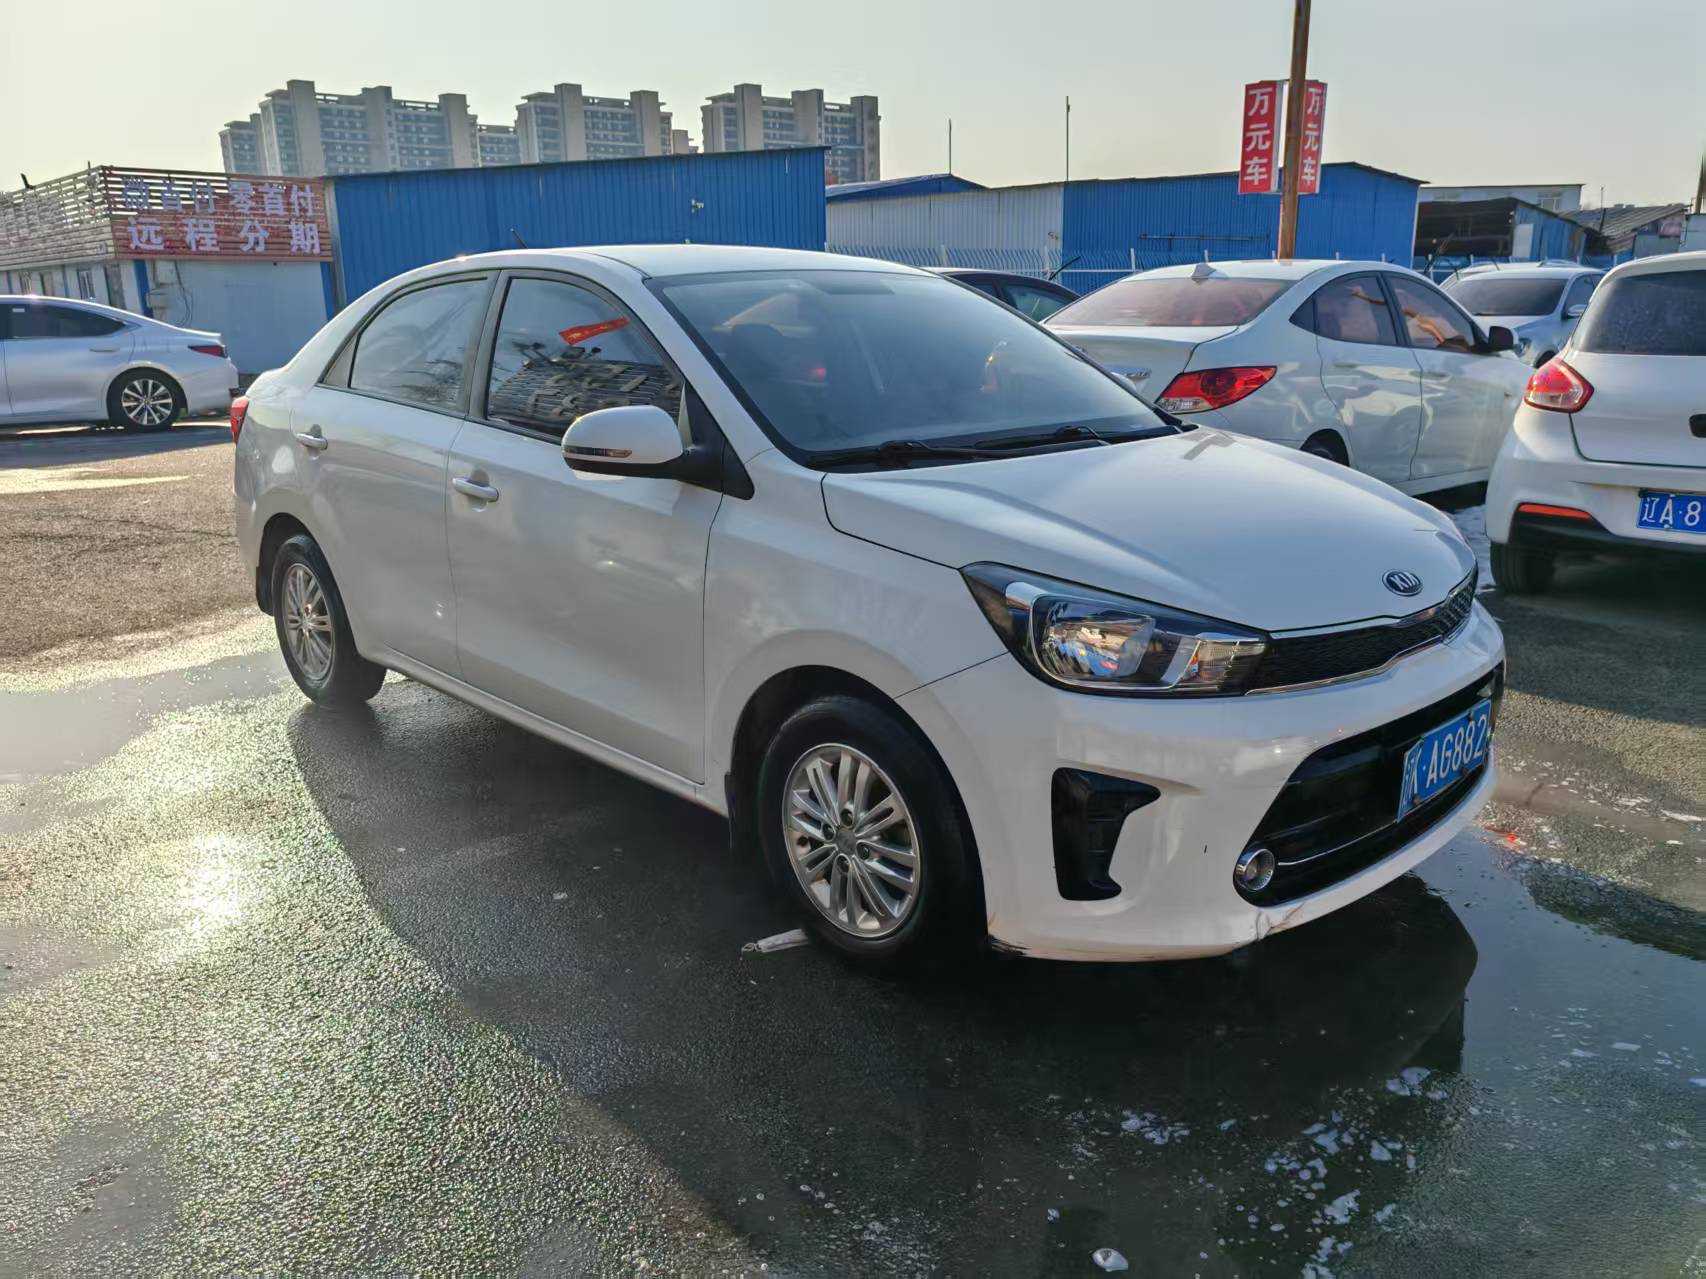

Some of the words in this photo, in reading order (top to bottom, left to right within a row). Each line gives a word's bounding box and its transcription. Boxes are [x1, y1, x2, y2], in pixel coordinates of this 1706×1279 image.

[1244, 87, 1272, 185] 万元车
[1301, 87, 1321, 185] 万元车
[127, 216, 320, 255] 远程分期
[1386, 571, 1419, 591] KIA
